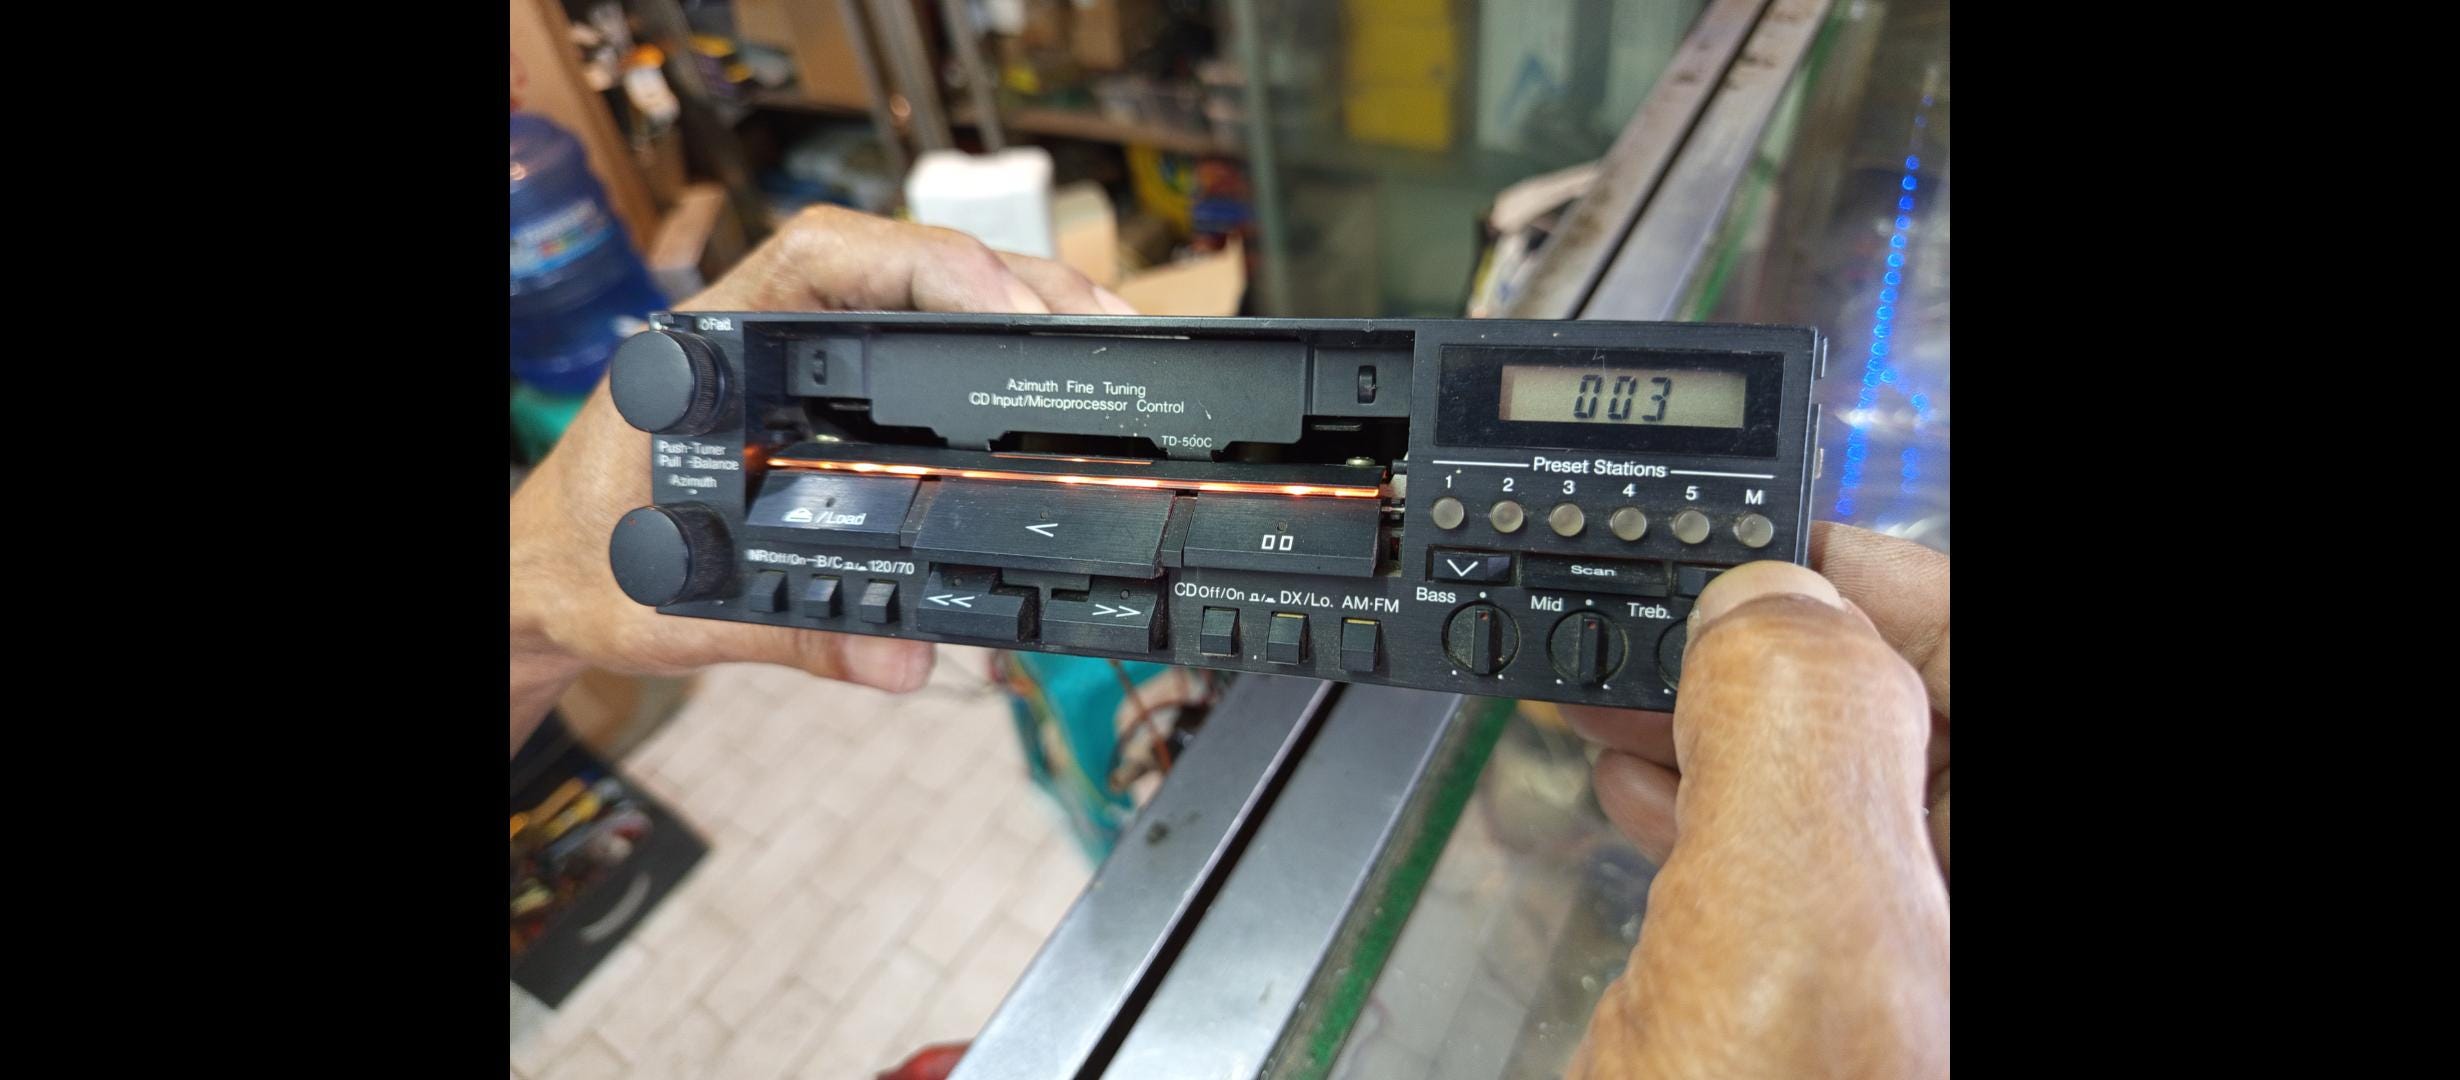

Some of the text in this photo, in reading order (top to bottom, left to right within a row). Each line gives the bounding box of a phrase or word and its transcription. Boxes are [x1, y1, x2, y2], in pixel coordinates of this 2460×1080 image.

[1007, 379, 1146, 397] Azimuth Fine Tuning
[969, 392, 1184, 414] CD Input/Microprocessor Control
[1573, 374, 1672, 422] 003
[1161, 435, 1212, 448] TD-500C
[659, 454, 683, 468] Pull
[1533, 456, 1667, 478] Preset Stations
[669, 474, 717, 488] Azimuth
[1446, 475, 1763, 505] 1 2 3 4 5 M
[870, 560, 915, 574] 120/70
[1571, 564, 1616, 577] Scan
[1174, 582, 1197, 597] CD
[1198, 585, 1244, 601] Off/On
[1280, 590, 1334, 608] DX/Lo.
[1415, 586, 1457, 604] Bass
[1530, 595, 1563, 612] Mid
[1627, 602, 1674, 620] Treb.
